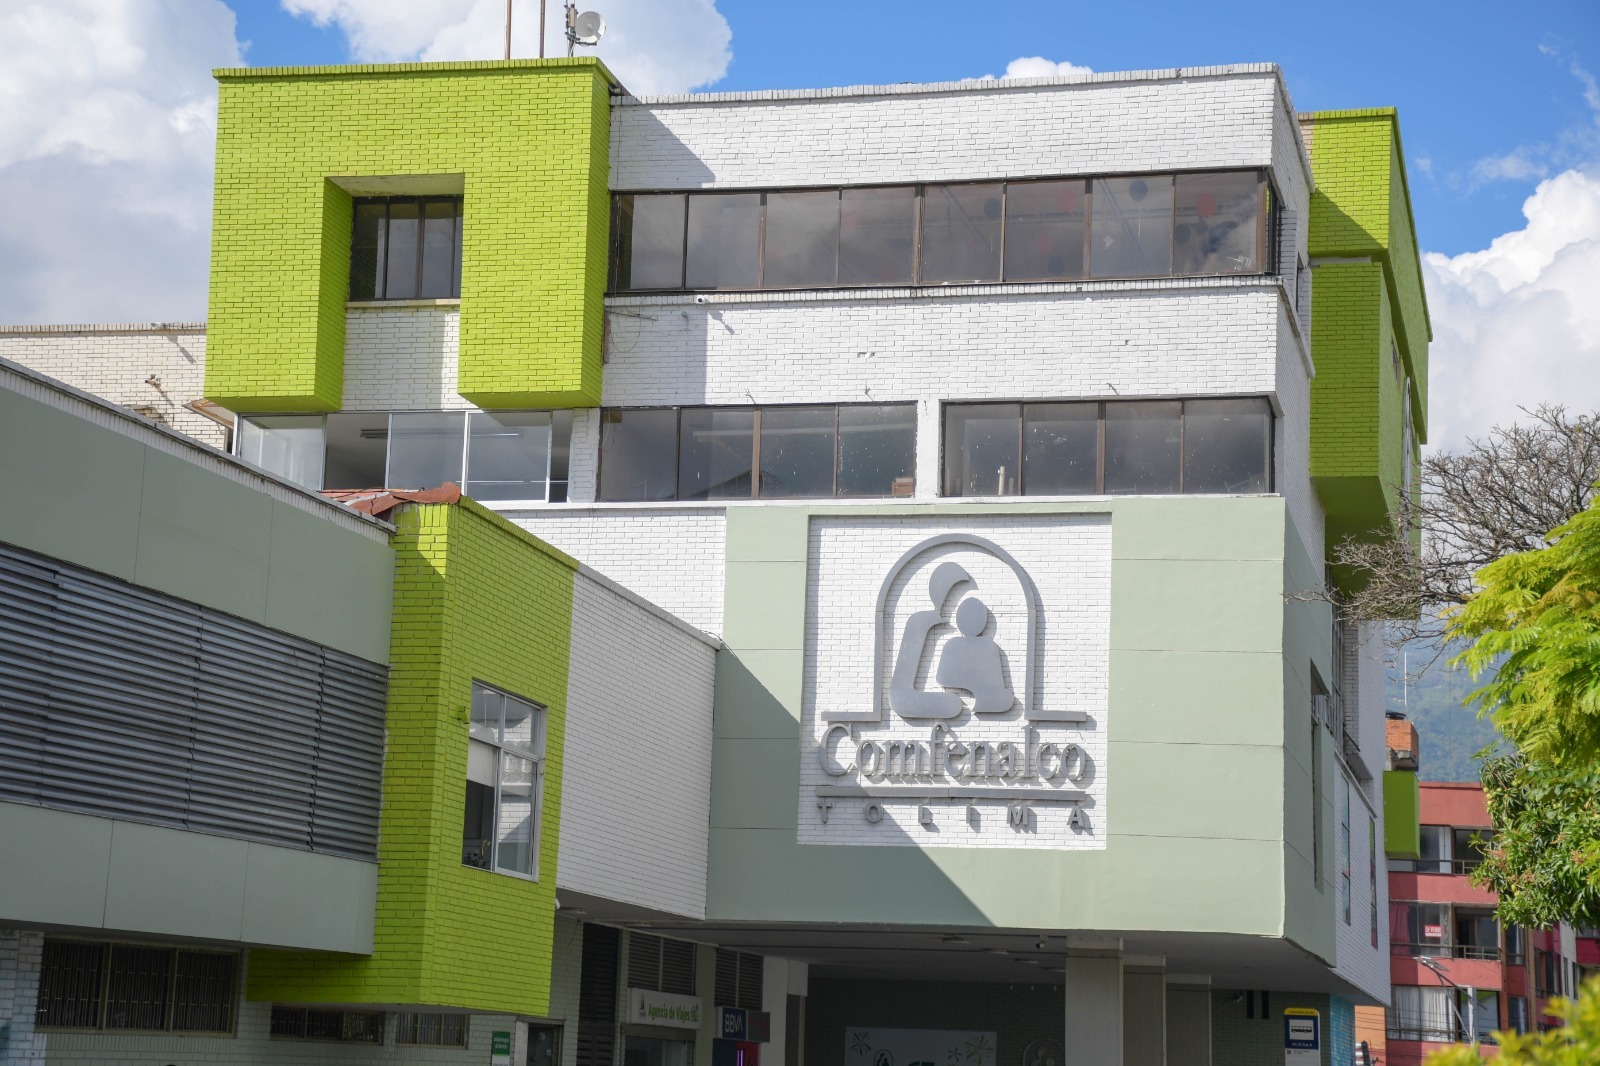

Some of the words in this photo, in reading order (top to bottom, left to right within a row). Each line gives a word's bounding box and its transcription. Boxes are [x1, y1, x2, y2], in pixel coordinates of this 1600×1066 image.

[819, 722, 1087, 781] Comfenalco
[816, 802, 1084, 827] TOLIMA
[648, 1003, 668, 1020] Agencia
[669, 1005, 675, 1019] de
[676, 1005, 690, 1024] Viajes
[725, 1013, 743, 1033] BBVA
